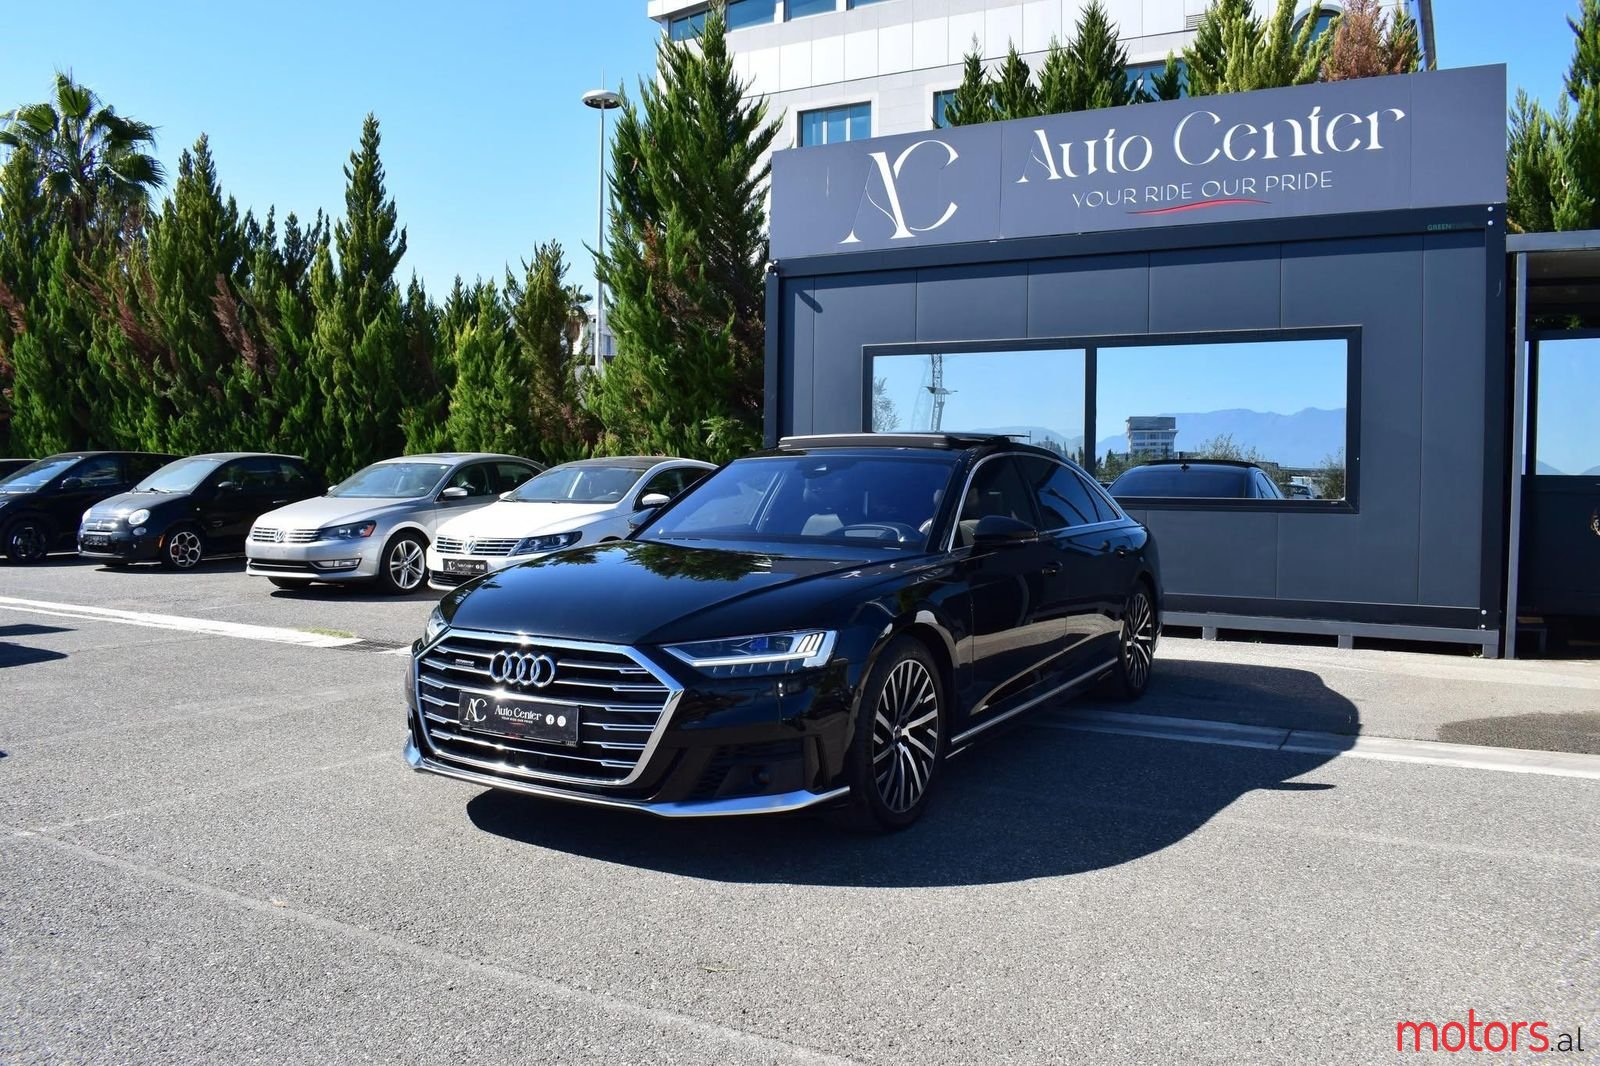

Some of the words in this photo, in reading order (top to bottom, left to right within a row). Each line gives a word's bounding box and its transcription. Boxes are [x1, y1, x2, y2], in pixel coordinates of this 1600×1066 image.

[1015, 128, 1153, 184] Auto
[1173, 105, 1406, 166] Center
[838, 139, 959, 245] AC
[1072, 188, 1137, 208] YOUR
[1145, 183, 1193, 203] RIDE
[1201, 177, 1257, 198] OUR
[1265, 170, 1334, 193] PRIDE
[464, 698, 488, 722] AC
[495, 704, 513, 718] Auto
[513, 707, 543, 721] Center
